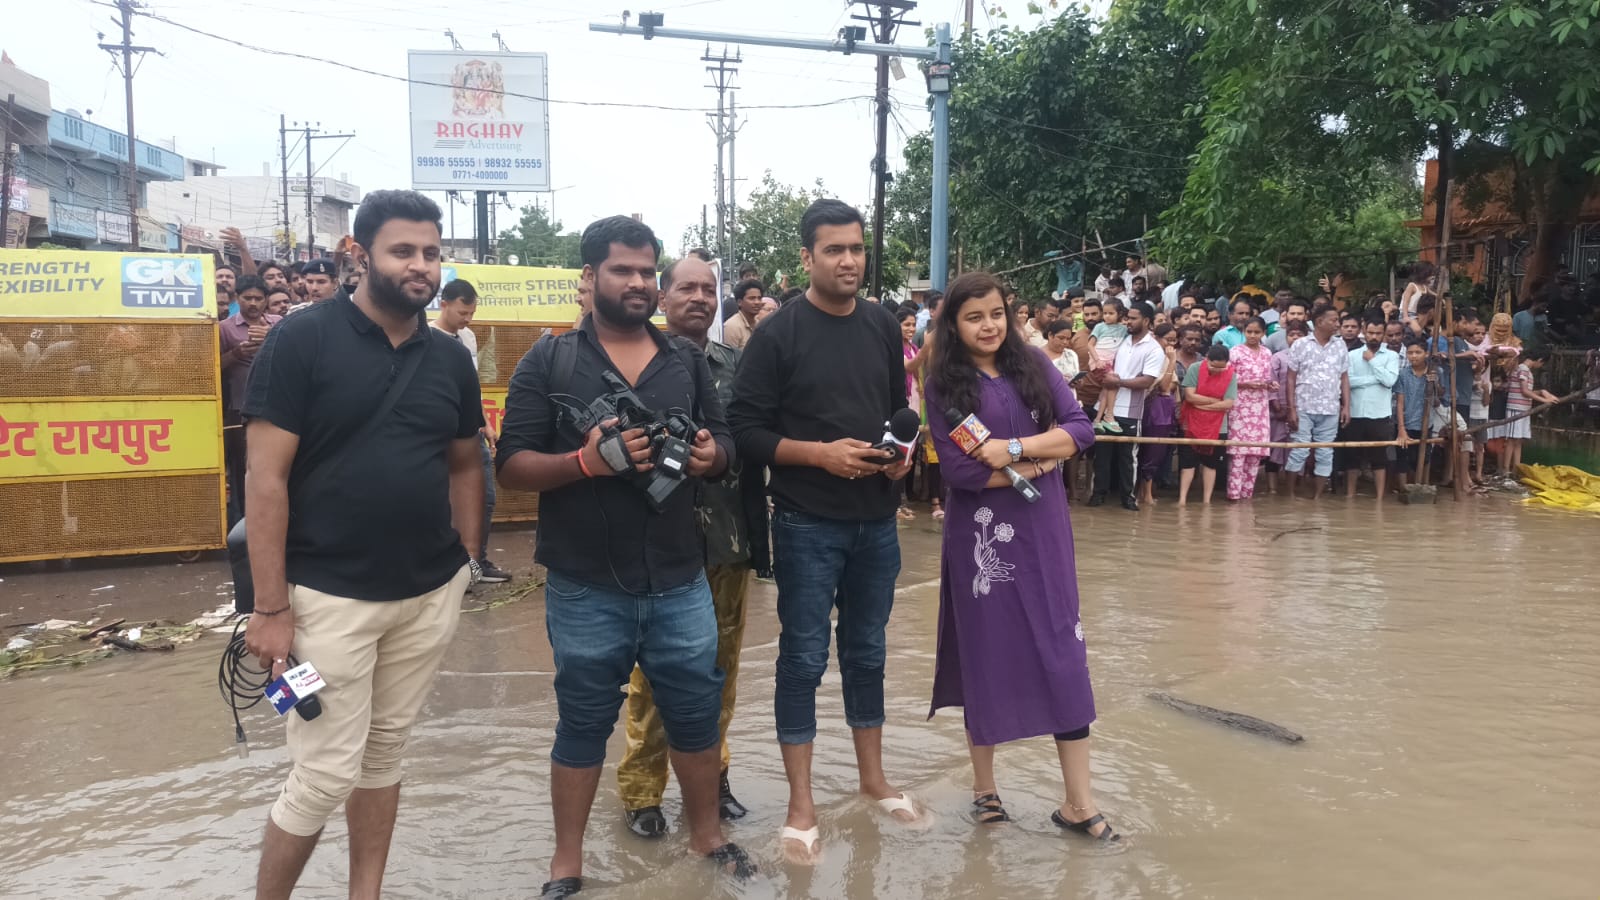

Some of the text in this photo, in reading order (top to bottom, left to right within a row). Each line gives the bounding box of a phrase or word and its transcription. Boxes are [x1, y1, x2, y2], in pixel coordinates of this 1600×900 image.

[436, 122, 524, 139] RAGHAV
[467, 139, 522, 153] Advertising
[417, 156, 542, 169] 99936 55555 98932 55555
[452, 170, 509, 180] 0771-4000000
[125, 258, 200, 286] GK
[0, 277, 105, 295] XIBILITY
[129, 290, 196, 305] TMT
[47, 417, 174, 466] रायपुर
